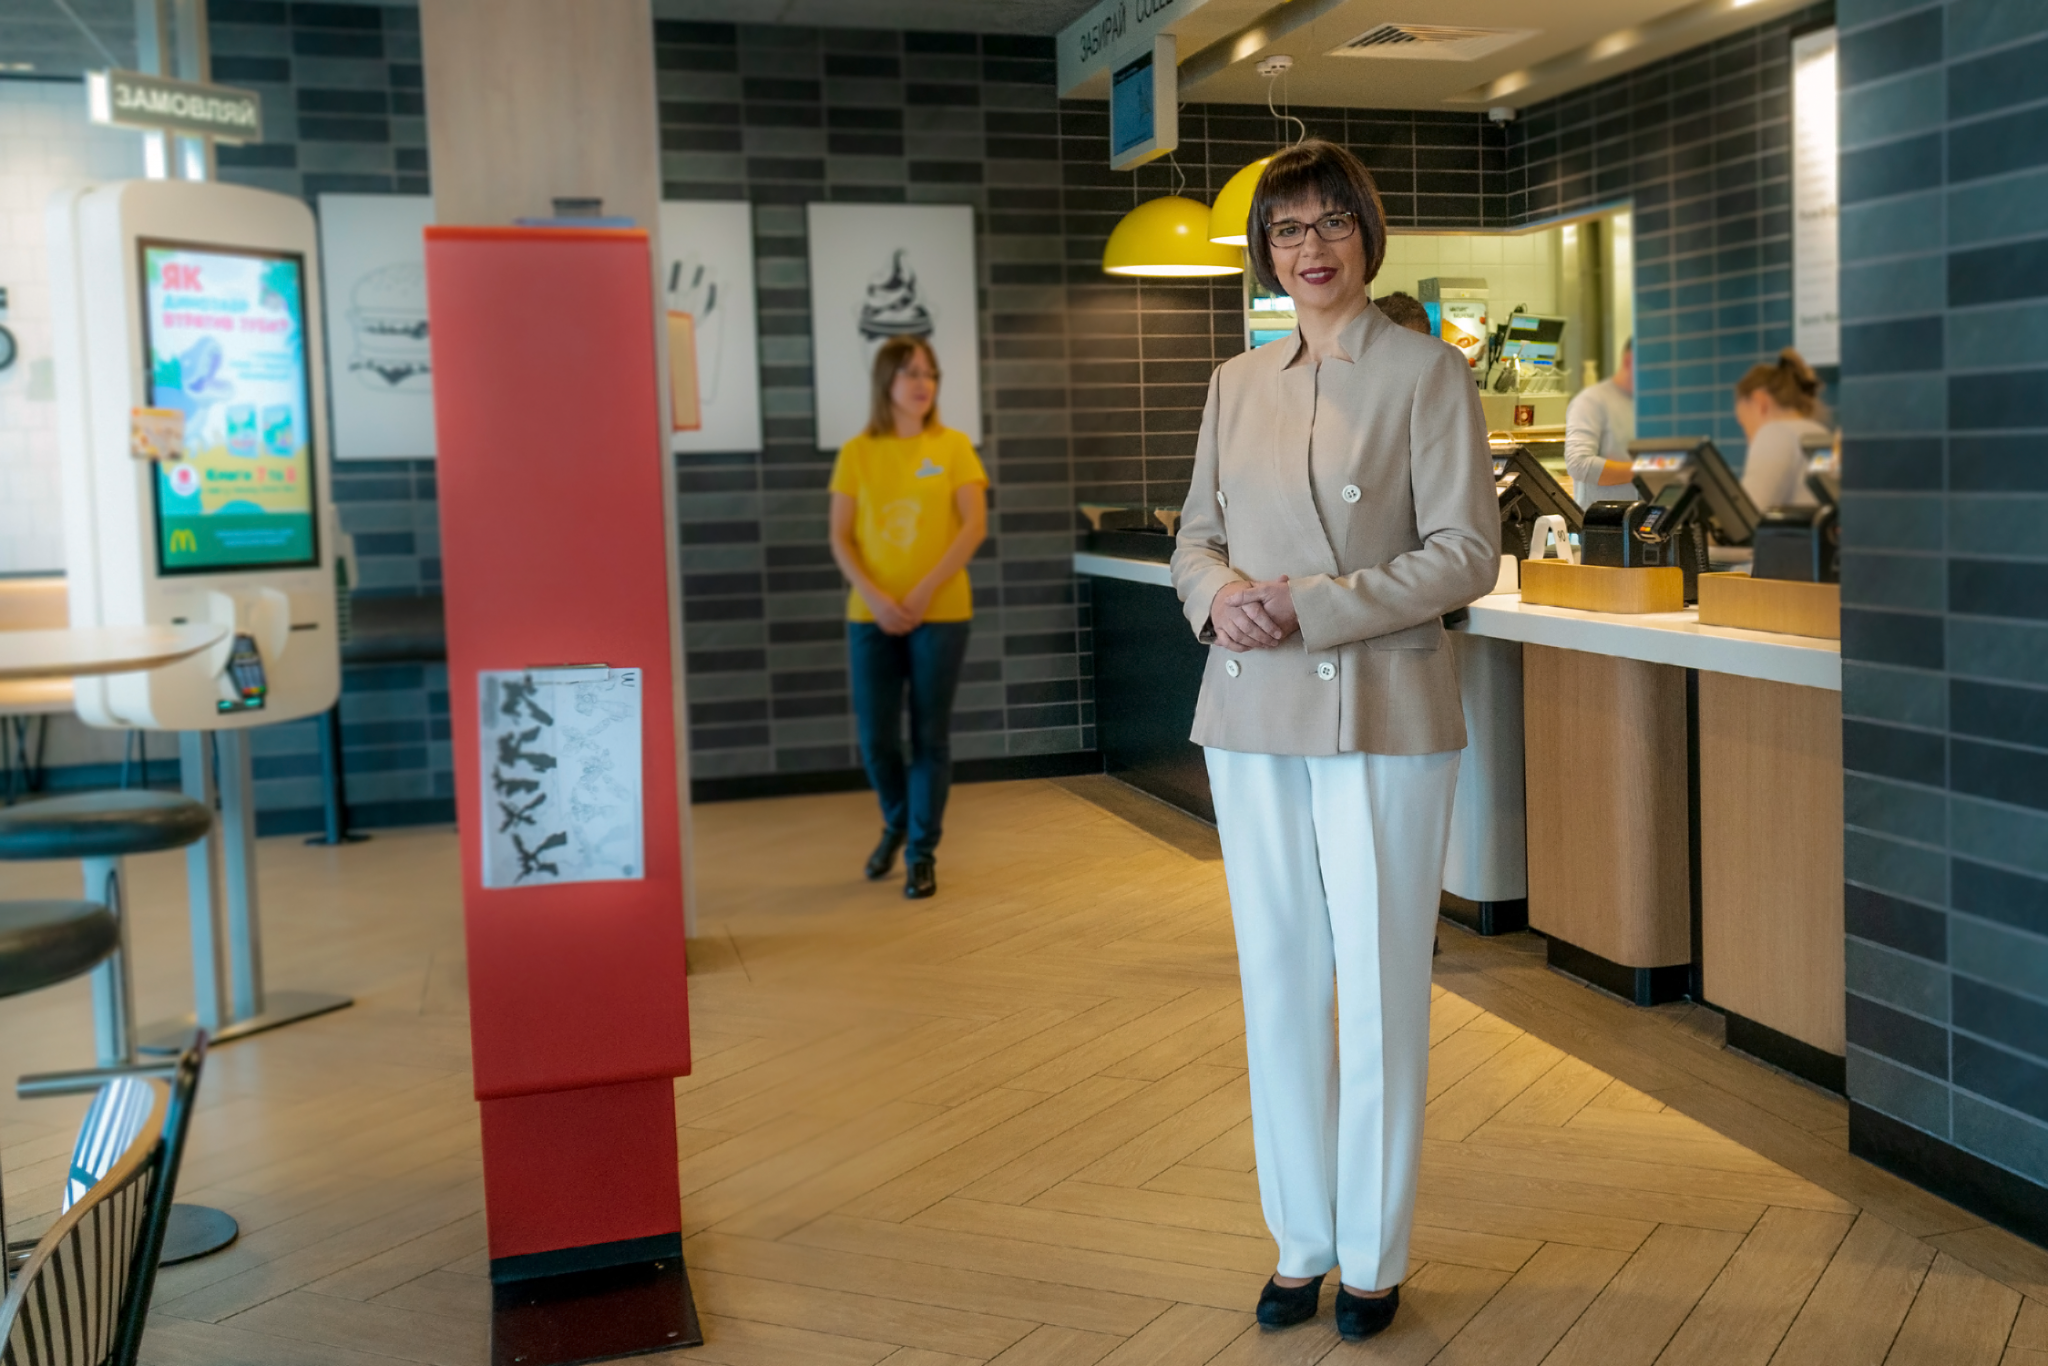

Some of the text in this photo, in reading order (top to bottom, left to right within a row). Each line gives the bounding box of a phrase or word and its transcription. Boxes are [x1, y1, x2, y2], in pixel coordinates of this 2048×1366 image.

[1080, 1, 1126, 63] ЗАБИРАЙ
[115, 82, 257, 128] ЗАМОВЛЯЙ
[161, 262, 202, 292] ЯК
